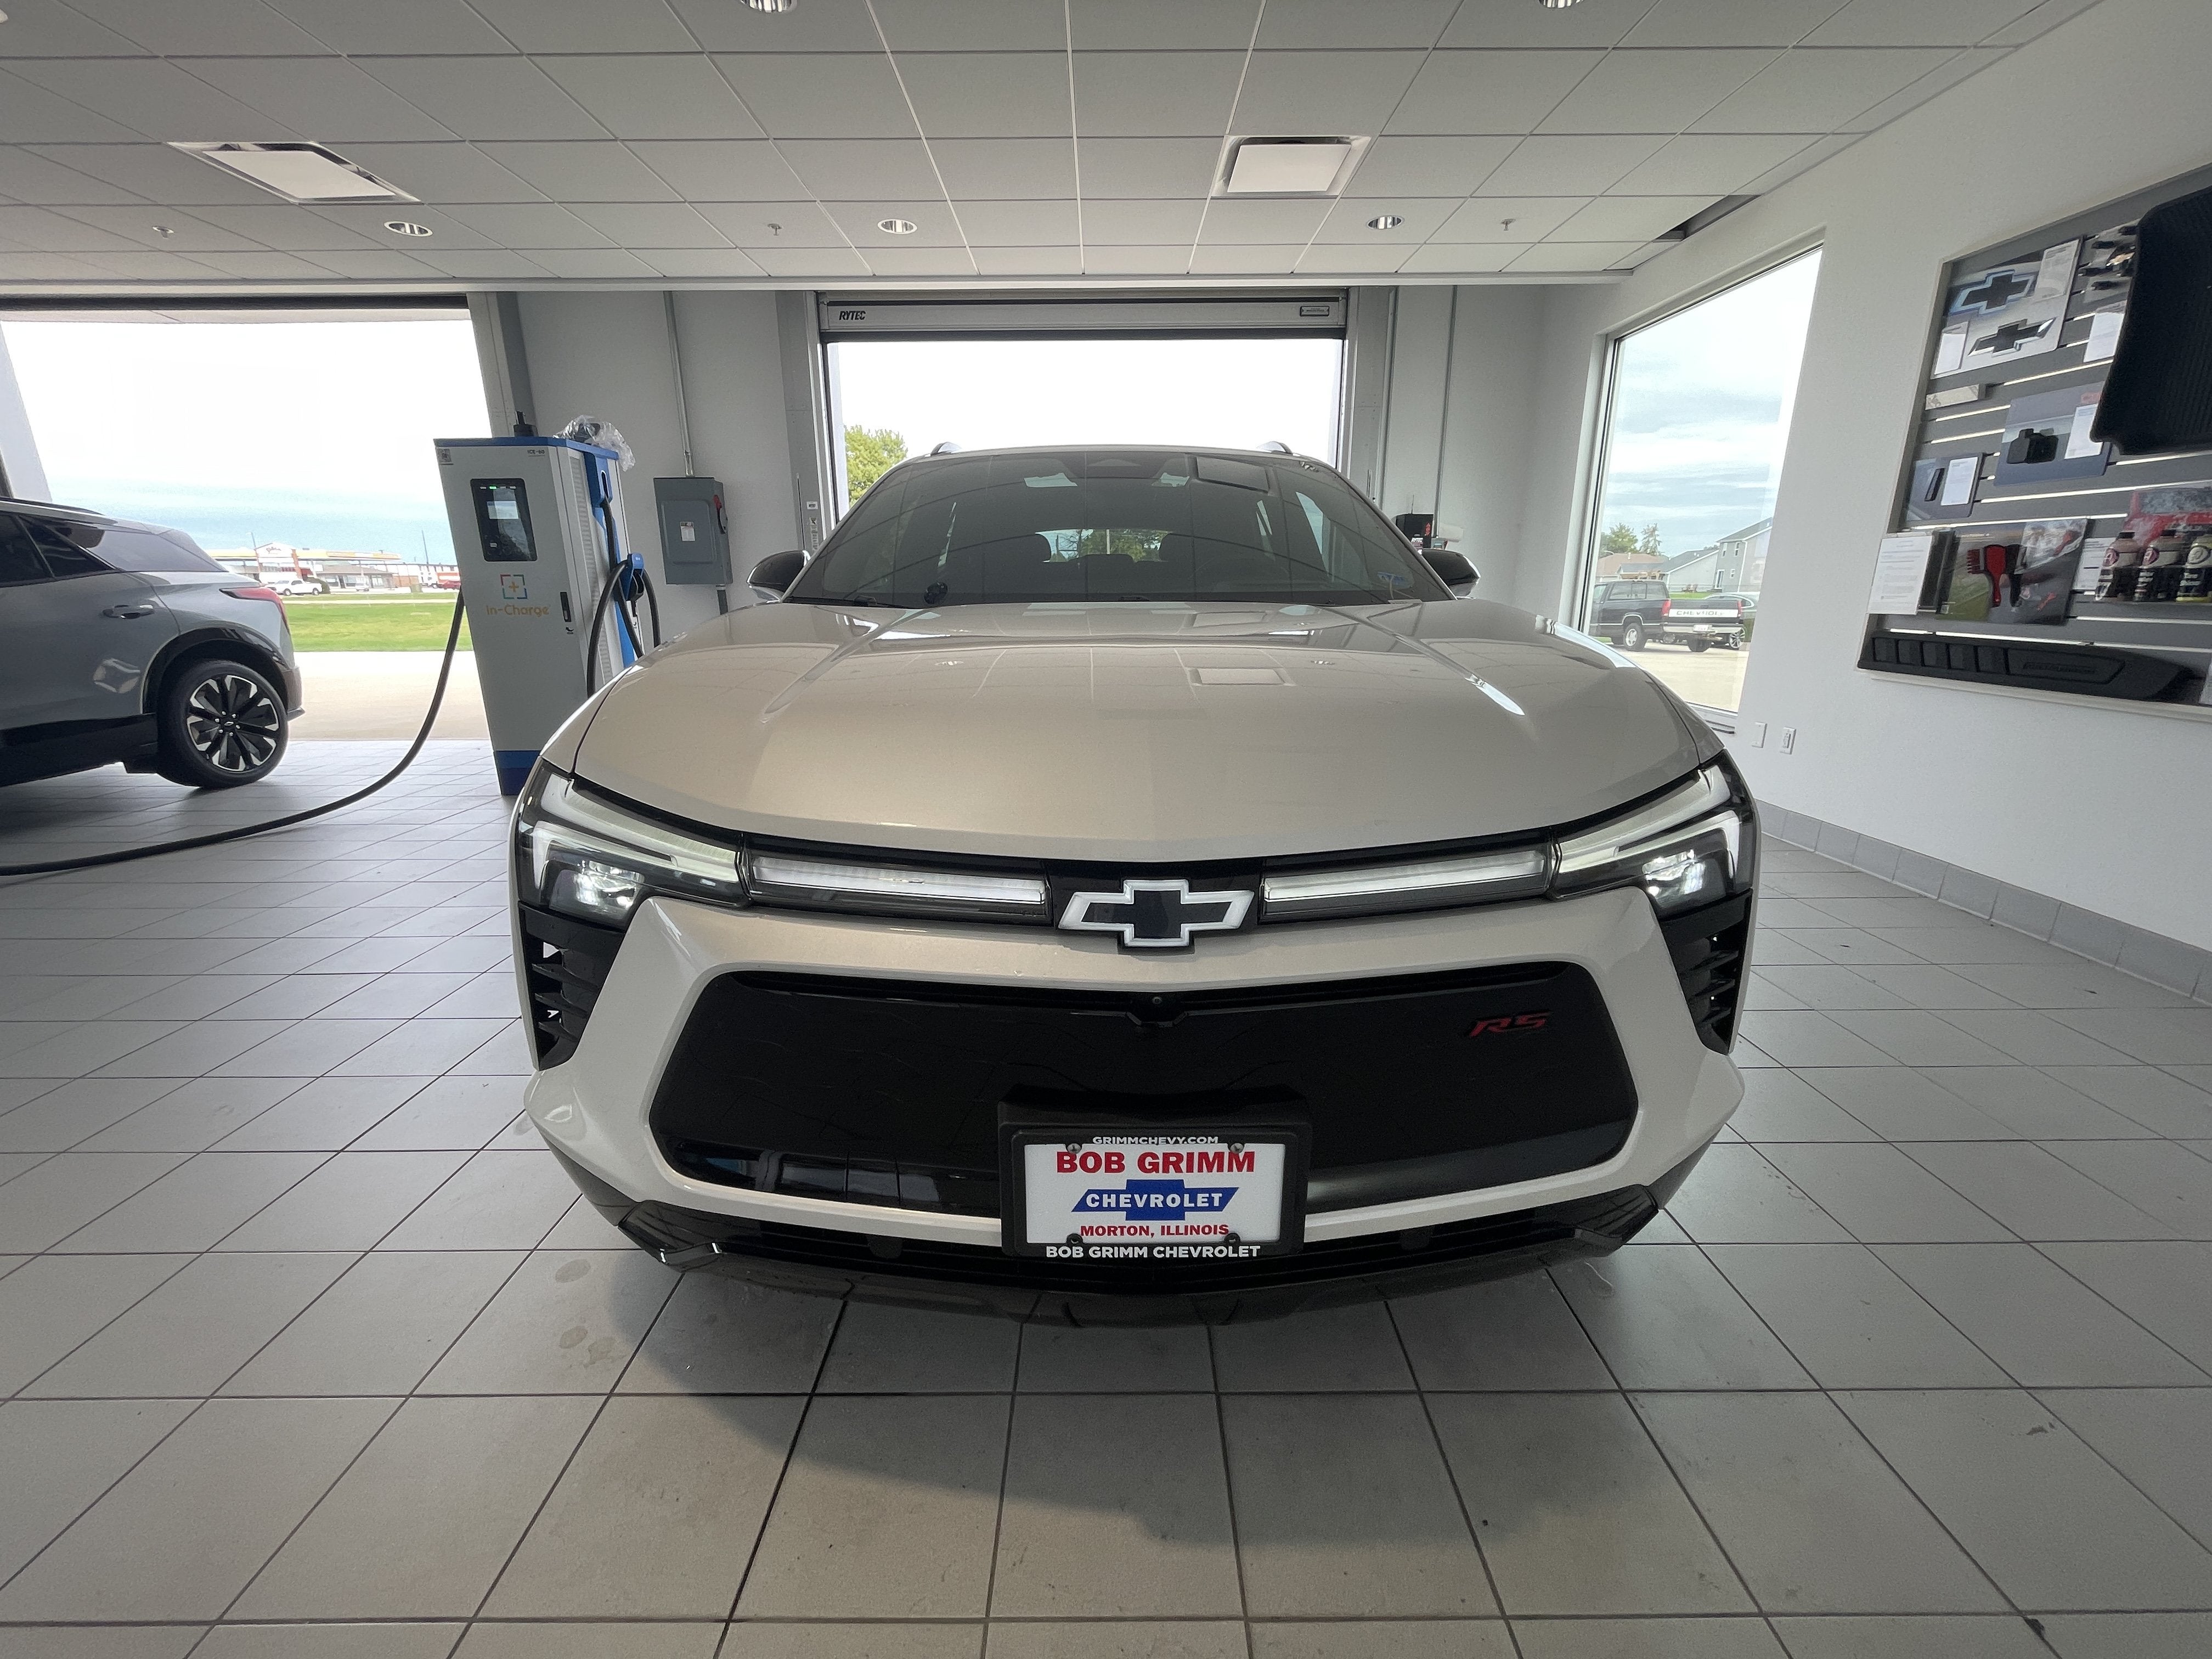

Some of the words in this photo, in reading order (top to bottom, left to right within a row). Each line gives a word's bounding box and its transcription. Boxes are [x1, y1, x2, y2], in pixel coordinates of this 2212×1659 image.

[838, 311, 866, 320] RYTEC
[1469, 1013, 1552, 1037] RS
[1092, 1136, 1218, 1145] GRIMMCHEVY.COM
[1057, 1151, 1126, 1173] BOB
[1137, 1151, 1255, 1174] GRIMM
[1086, 1193, 1223, 1208] CHEVROLET
[1080, 1226, 1155, 1239] MORTON,
[1160, 1224, 1229, 1236] ILLINOIS
[1046, 1246, 1084, 1259] BOB
[1088, 1246, 1148, 1259] GRIMM
[1153, 1245, 1261, 1259] CHEVROLET
